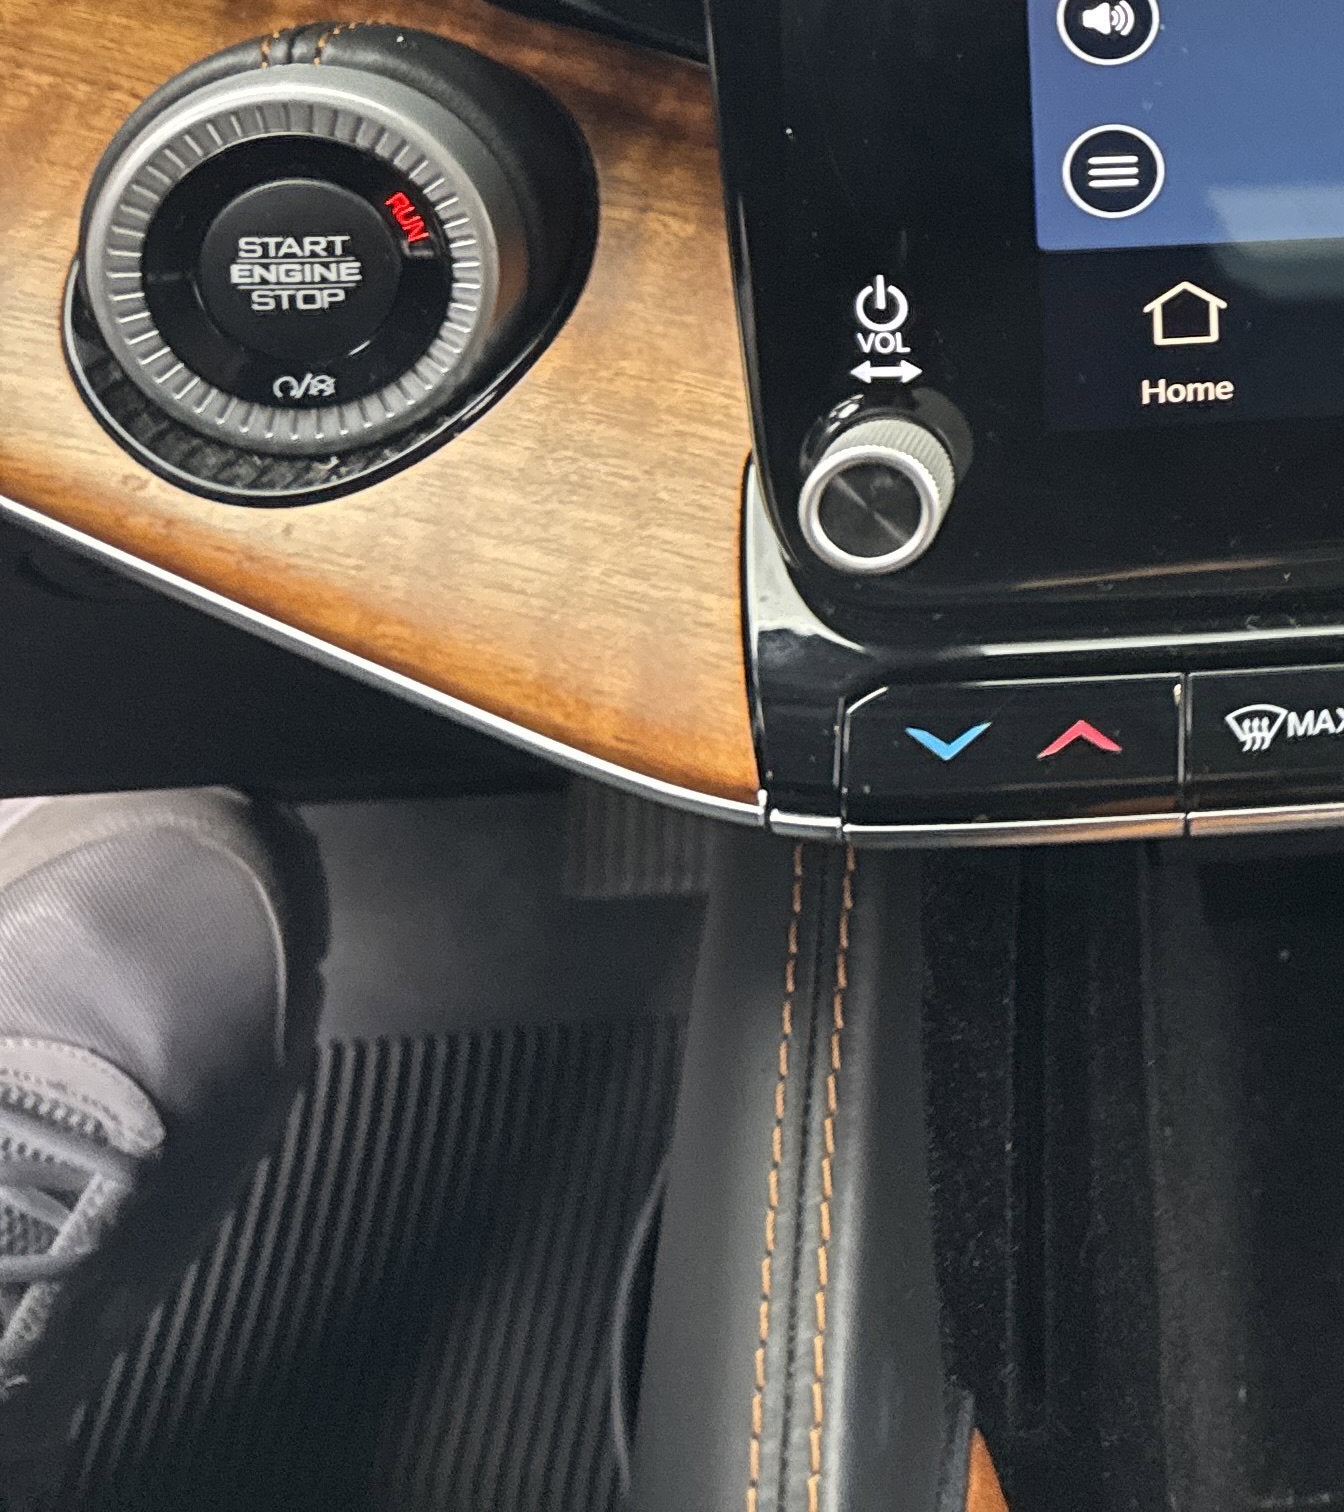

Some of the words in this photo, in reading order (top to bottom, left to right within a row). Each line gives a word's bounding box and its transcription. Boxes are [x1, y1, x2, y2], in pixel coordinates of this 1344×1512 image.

[384, 191, 430, 243] RUN
[237, 235, 351, 258] START
[230, 261, 362, 285] ENGINE
[251, 288, 346, 311] STOP
[856, 331, 912, 355] VOL
[1141, 377, 1235, 406] Home
